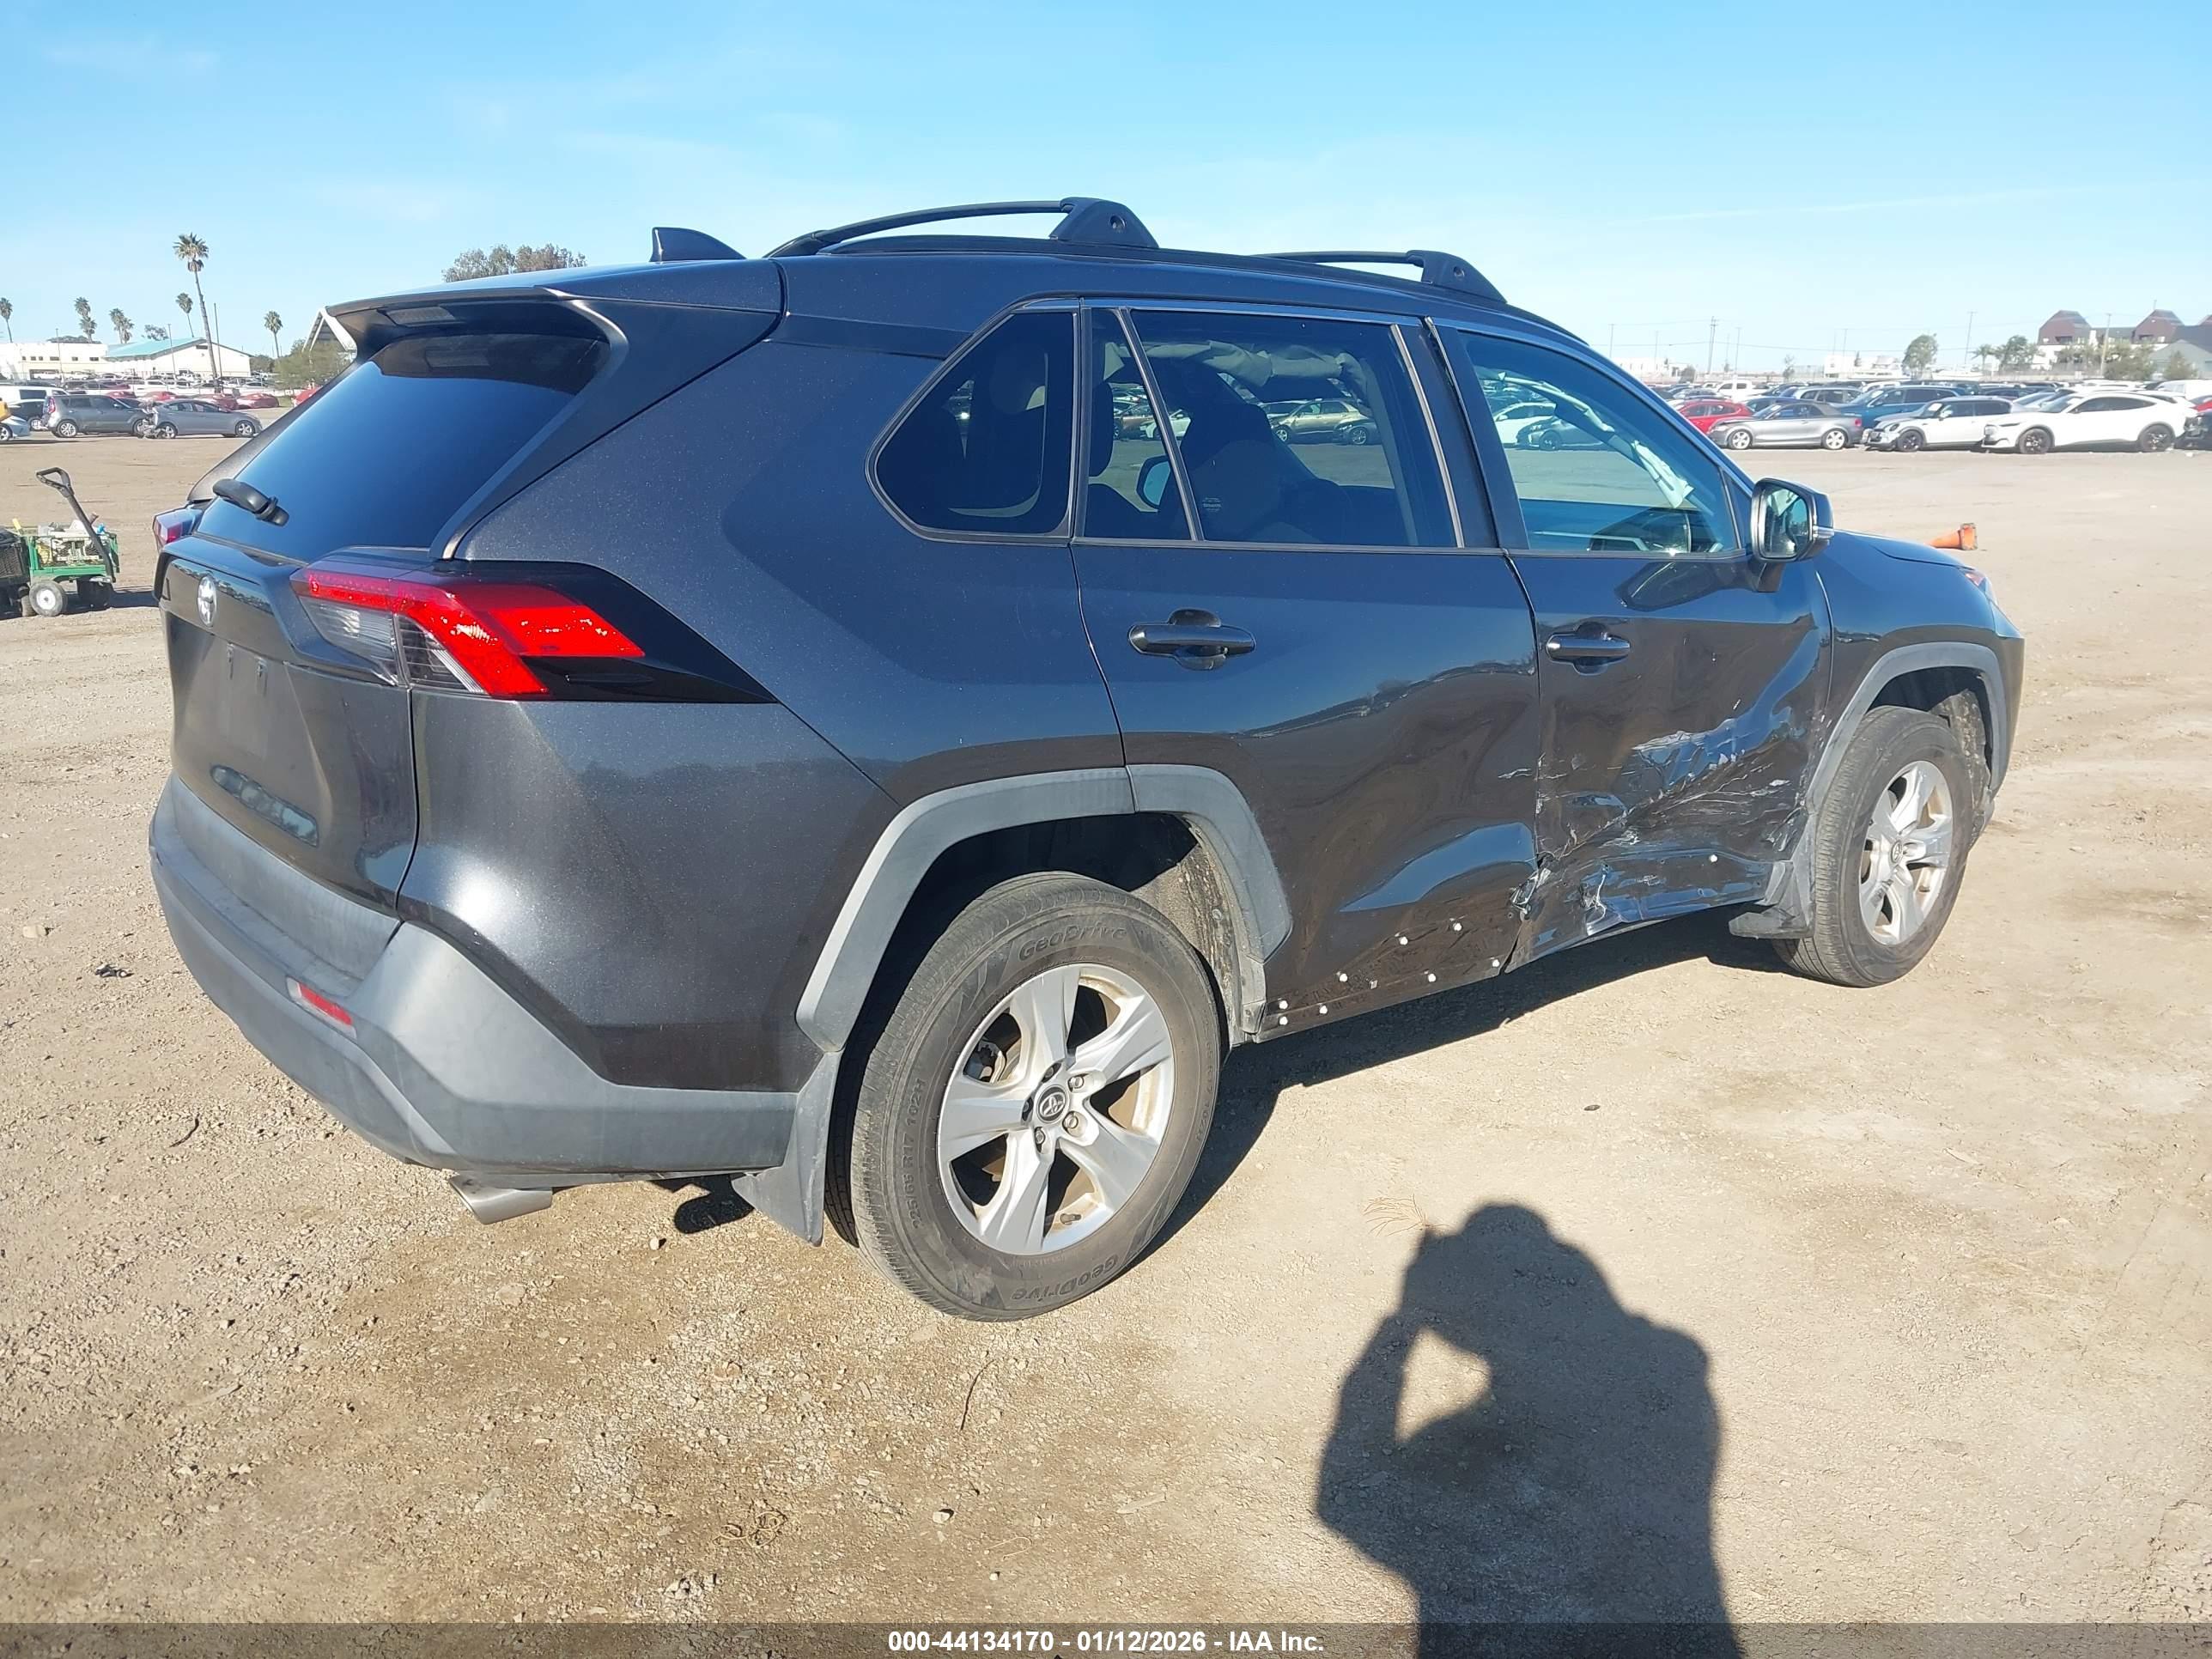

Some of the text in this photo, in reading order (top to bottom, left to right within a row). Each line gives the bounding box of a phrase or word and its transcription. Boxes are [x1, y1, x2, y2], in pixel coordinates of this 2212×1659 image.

[1018, 921, 1127, 960] GeoDrive
[904, 1078, 927, 1126] 102H
[901, 1132, 915, 1168] R17
[1009, 1254, 1118, 1303] GeoDrive
